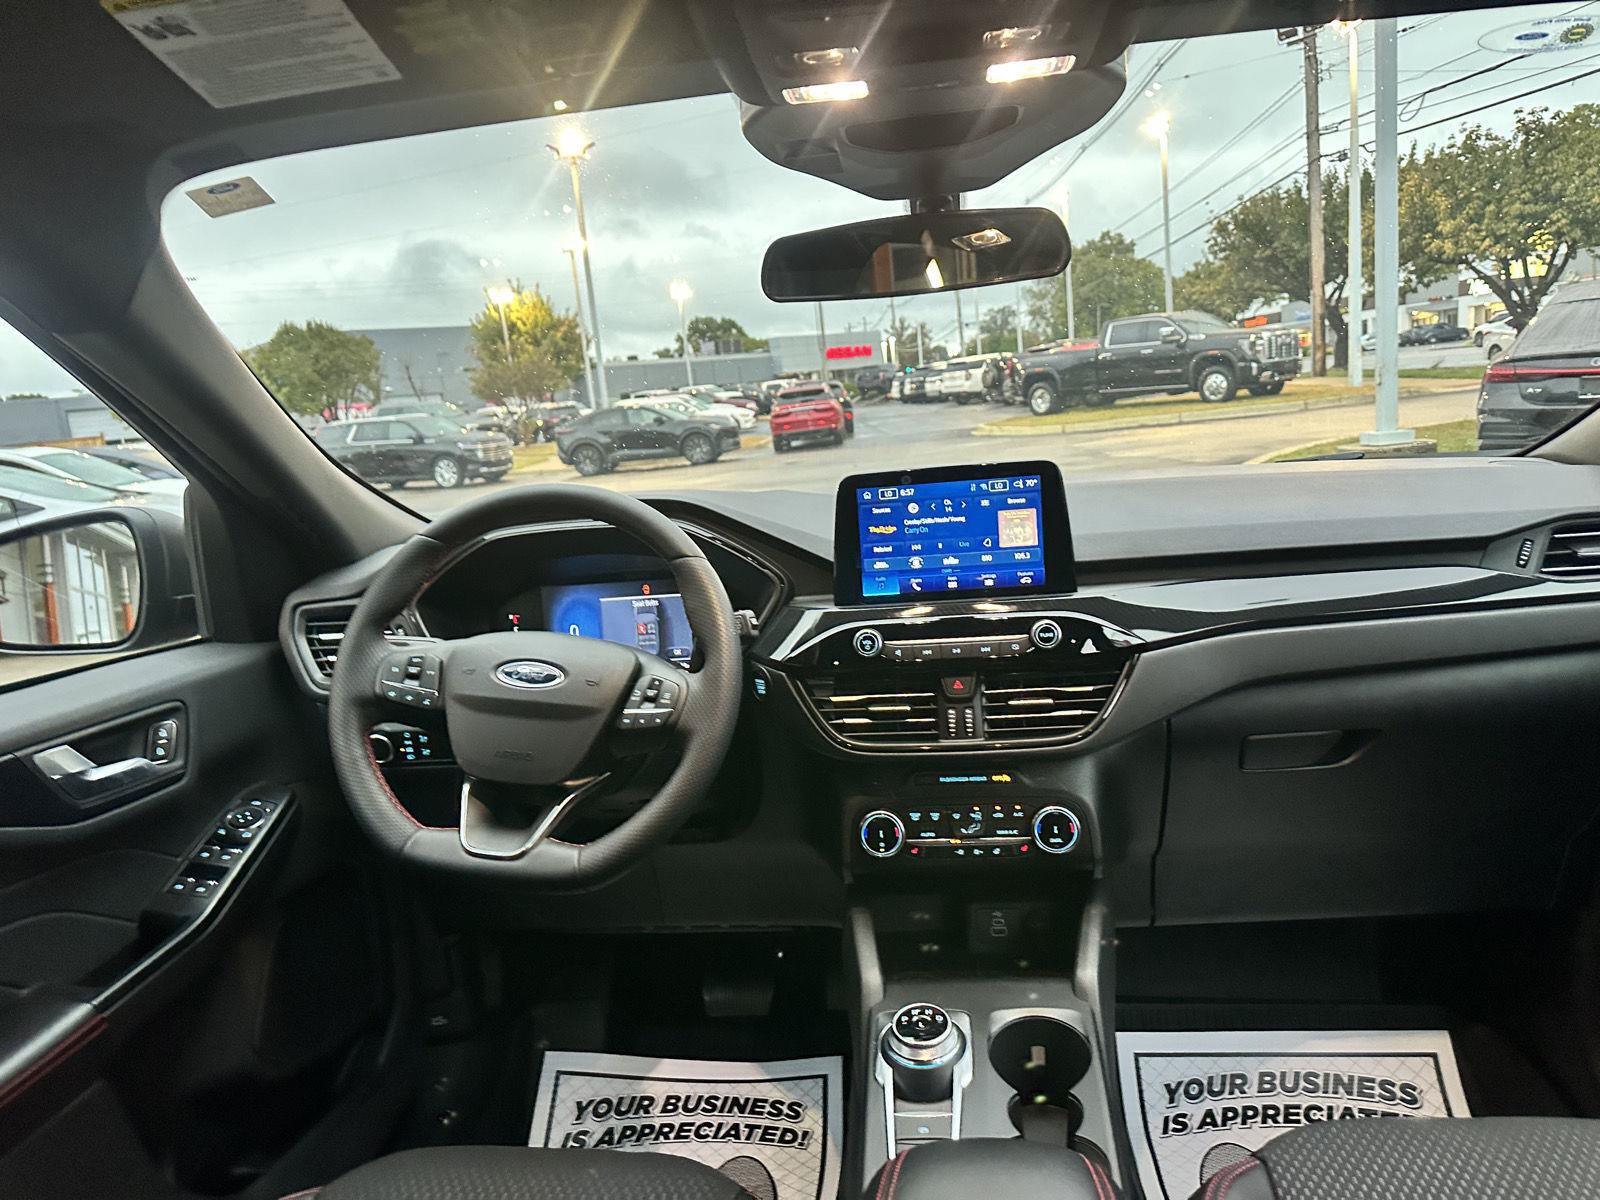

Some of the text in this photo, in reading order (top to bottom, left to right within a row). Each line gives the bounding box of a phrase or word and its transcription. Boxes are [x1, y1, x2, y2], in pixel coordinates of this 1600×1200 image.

[1163, 1070, 1424, 1109] YOUR BUSINESS
[574, 1093, 807, 1124] YOUR BUSINESS
[1160, 1103, 1416, 1138] IS APPRECIA
[561, 1121, 813, 1150] IS APPRECIATED!
